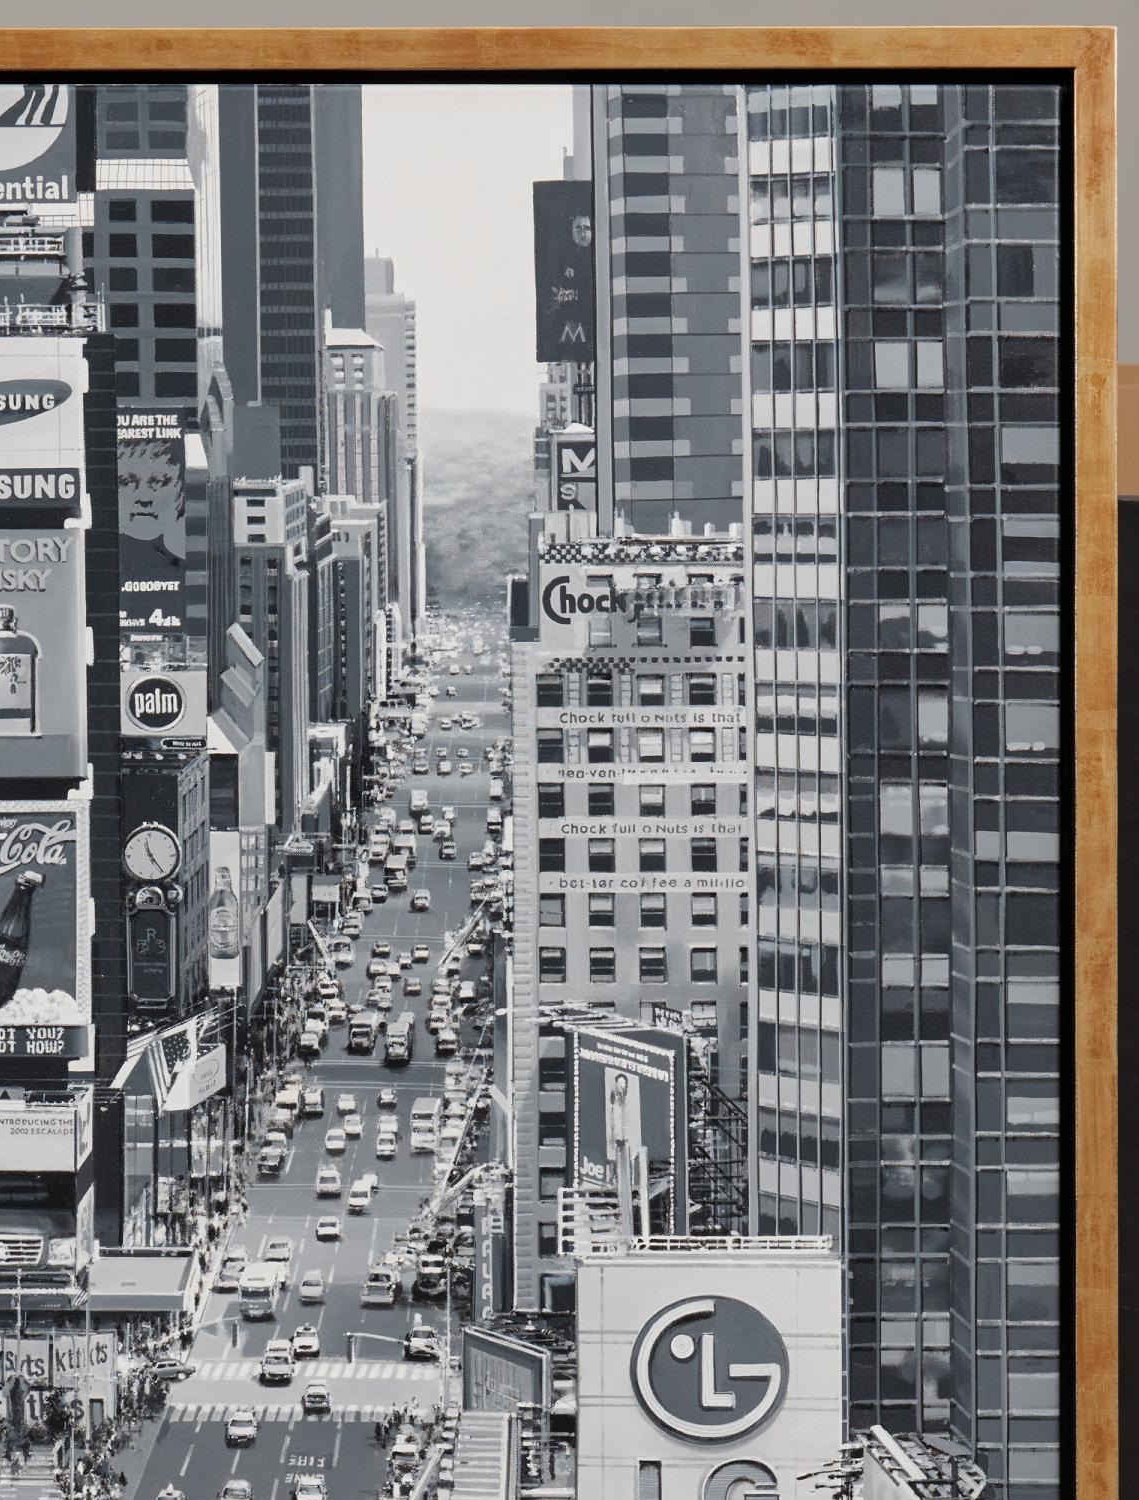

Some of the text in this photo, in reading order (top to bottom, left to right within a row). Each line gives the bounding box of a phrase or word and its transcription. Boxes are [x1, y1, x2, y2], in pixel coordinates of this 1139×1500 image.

[131, 414, 155, 426] ARE
[156, 414, 178, 426] THE
[156, 427, 182, 439] LINK
[542, 575, 627, 624] Chock
[134, 688, 179, 718] palm
[559, 711, 606, 724] Chock
[693, 711, 705, 724] is
[561, 822, 607, 835] Chock
[26, 1026, 65, 1040] YOU?
[58, 1118, 74, 1126] THE
[10, 1127, 74, 1135] 2002 ESCALADE
[580, 1156, 604, 1180] Joe
